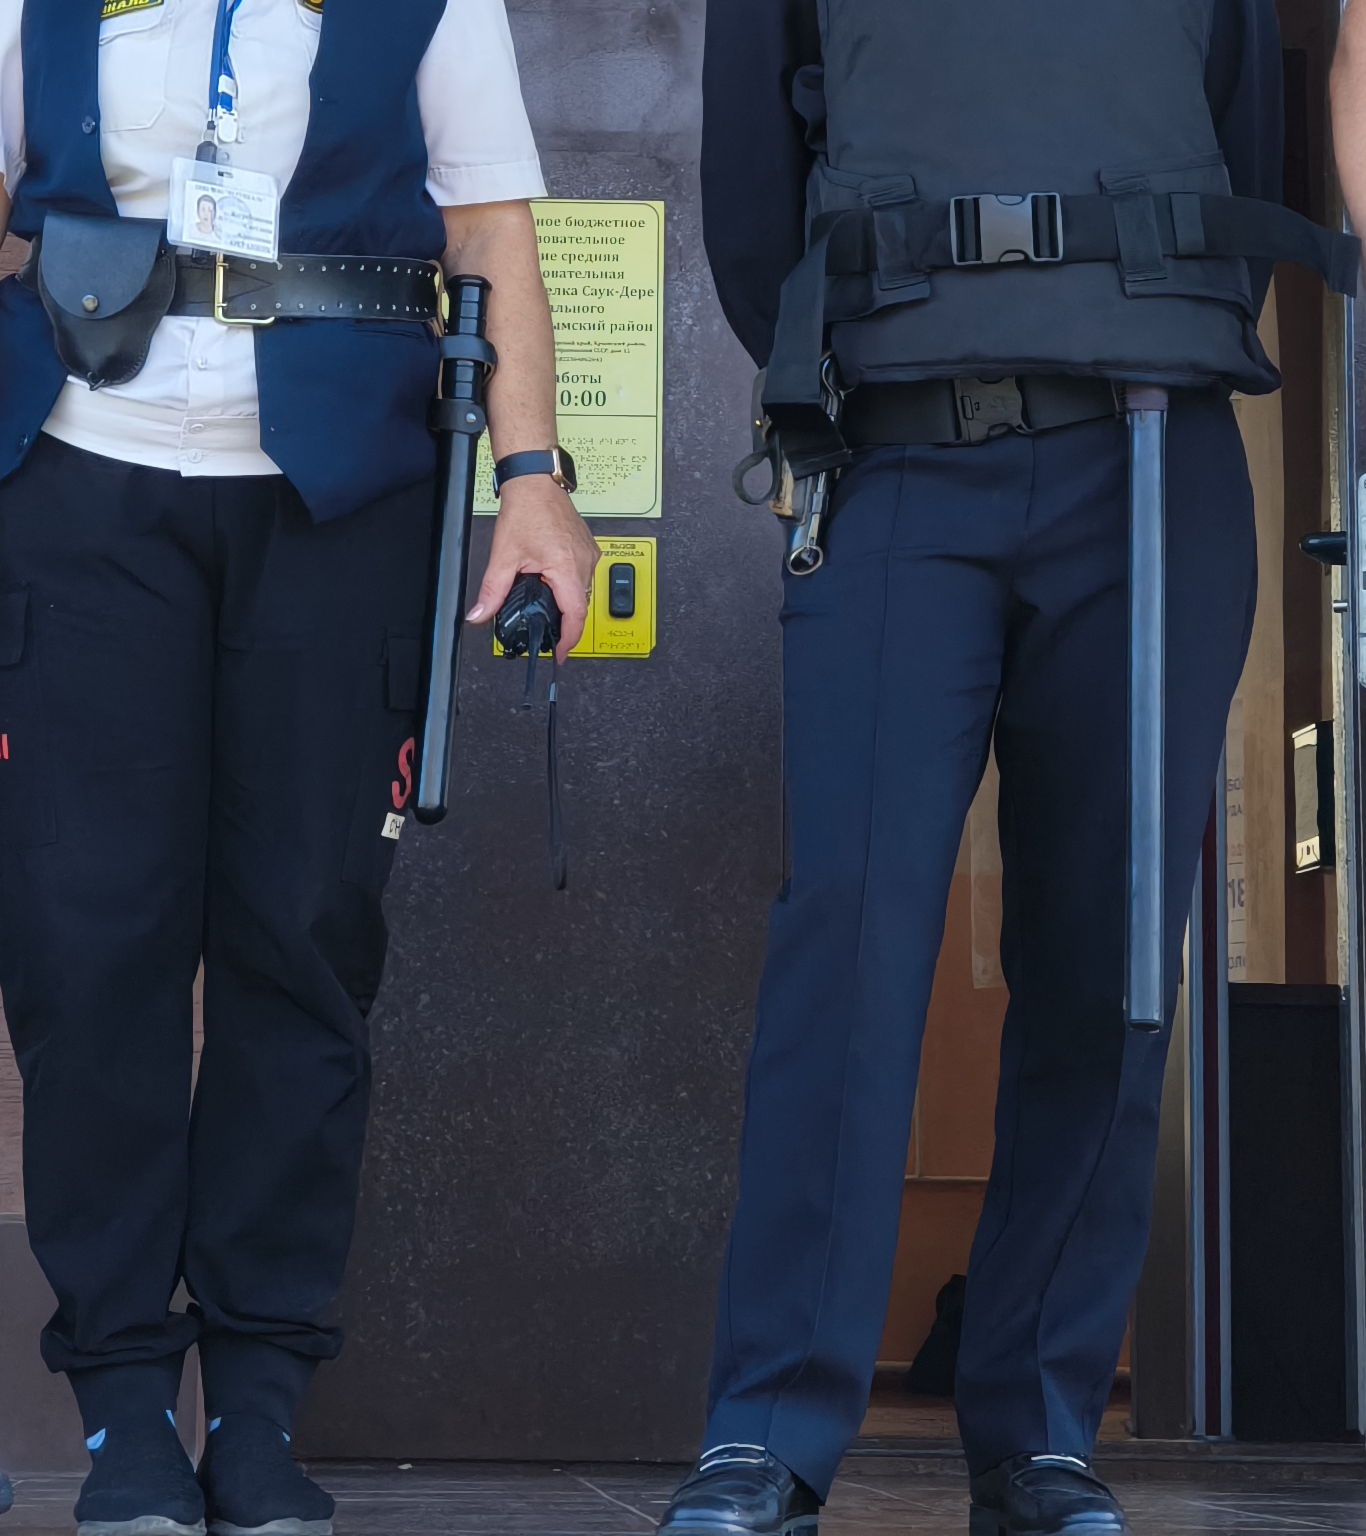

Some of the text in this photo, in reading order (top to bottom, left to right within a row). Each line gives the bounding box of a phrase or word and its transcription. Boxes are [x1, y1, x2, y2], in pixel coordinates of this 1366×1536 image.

[565, 216, 646, 228] бюджетное
[536, 234, 626, 245] зовательное
[561, 252, 620, 264] средняя
[542, 269, 625, 280] овательная
[546, 285, 655, 300] елка Саук-Дере
[553, 320, 654, 335] ымский район
[555, 371, 602, 384] аботы
[559, 389, 607, 407] 0:00
